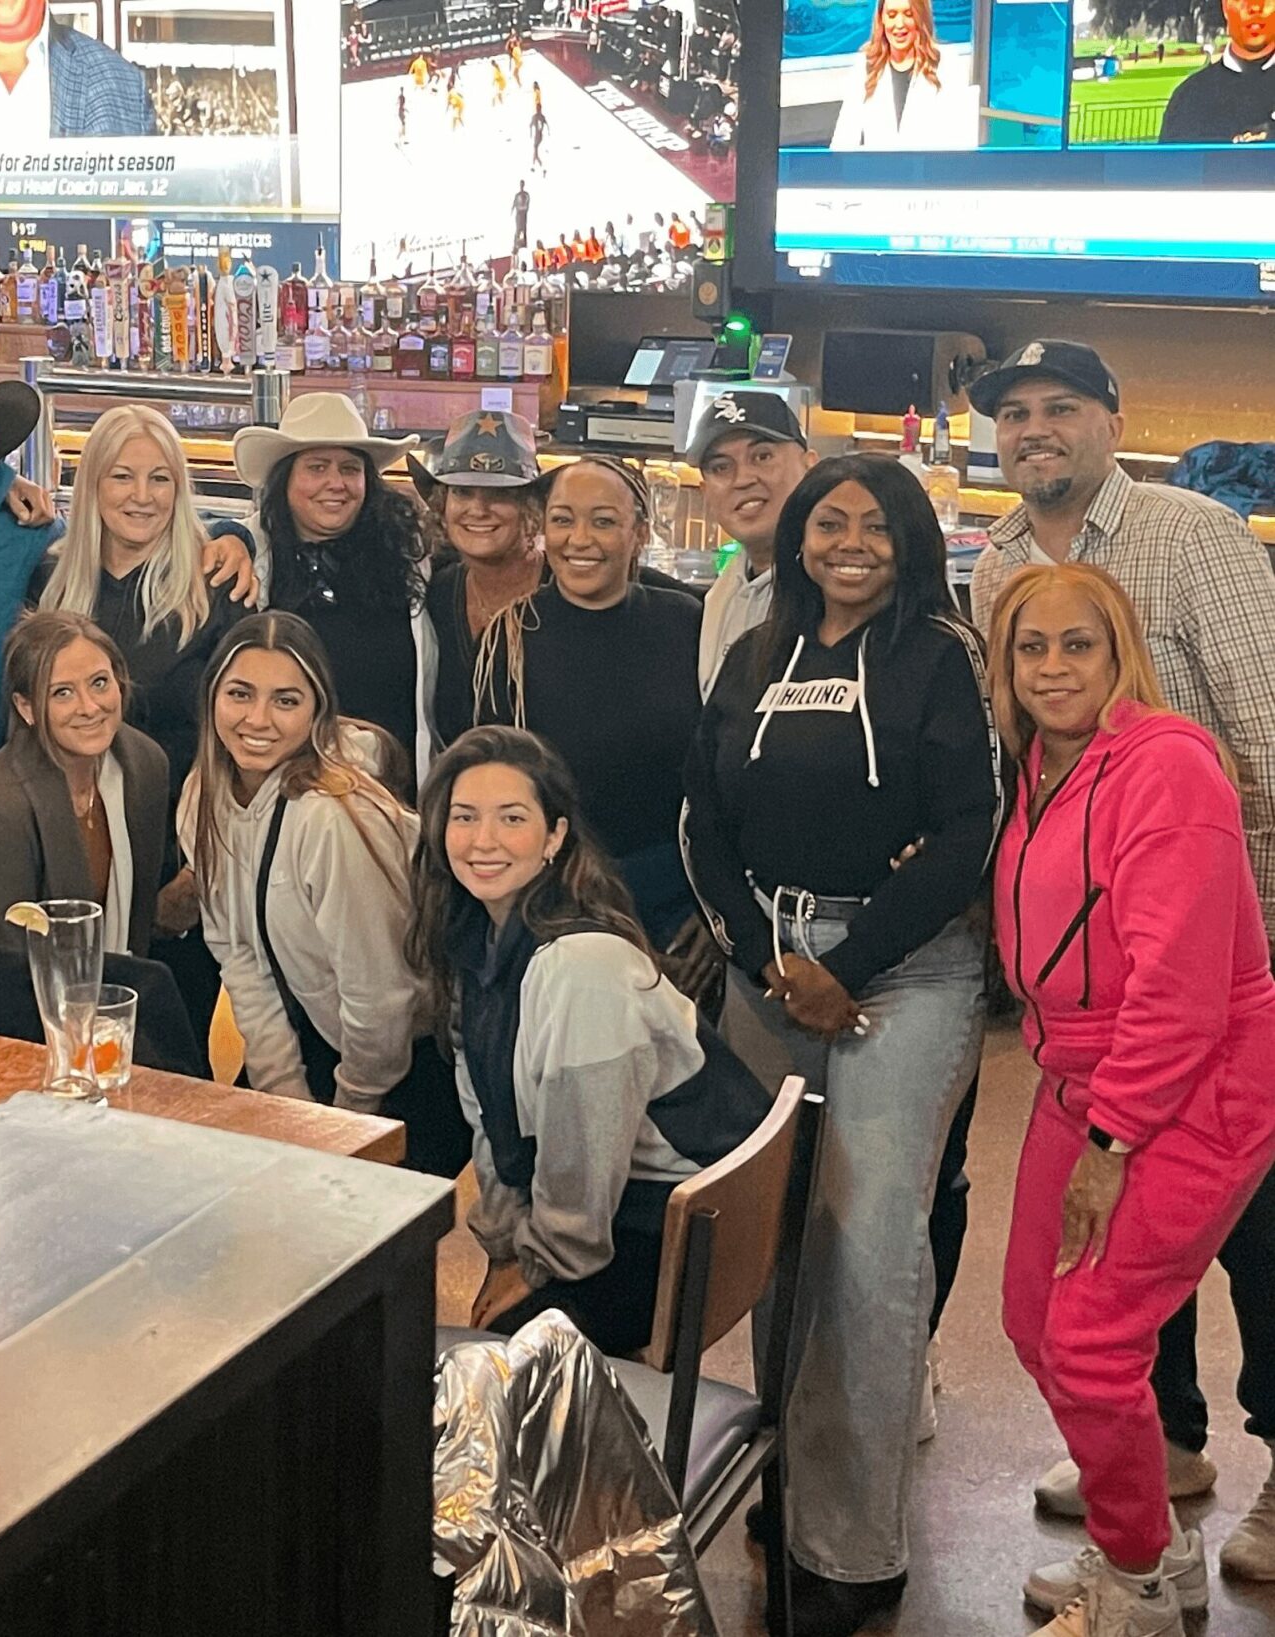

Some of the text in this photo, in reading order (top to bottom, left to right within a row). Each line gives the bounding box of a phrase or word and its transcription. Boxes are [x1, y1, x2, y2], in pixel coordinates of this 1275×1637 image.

[22, 154, 50, 172] 2nd
[52, 152, 114, 175] straight
[117, 154, 175, 172] season
[5, 181, 22, 196] as
[23, 178, 58, 196] Head
[58, 178, 99, 196] Coach
[100, 181, 118, 196] on
[119, 178, 148, 196] Jan.
[150, 178, 168, 196] 12
[163, 232, 209, 246] WARRIORS
[218, 233, 272, 248] MAVERICKS
[114, 283, 124, 322] Coors
[262, 302, 274, 323] Lite
[236, 299, 253, 353] Coors
[714, 392, 746, 424] Sox
